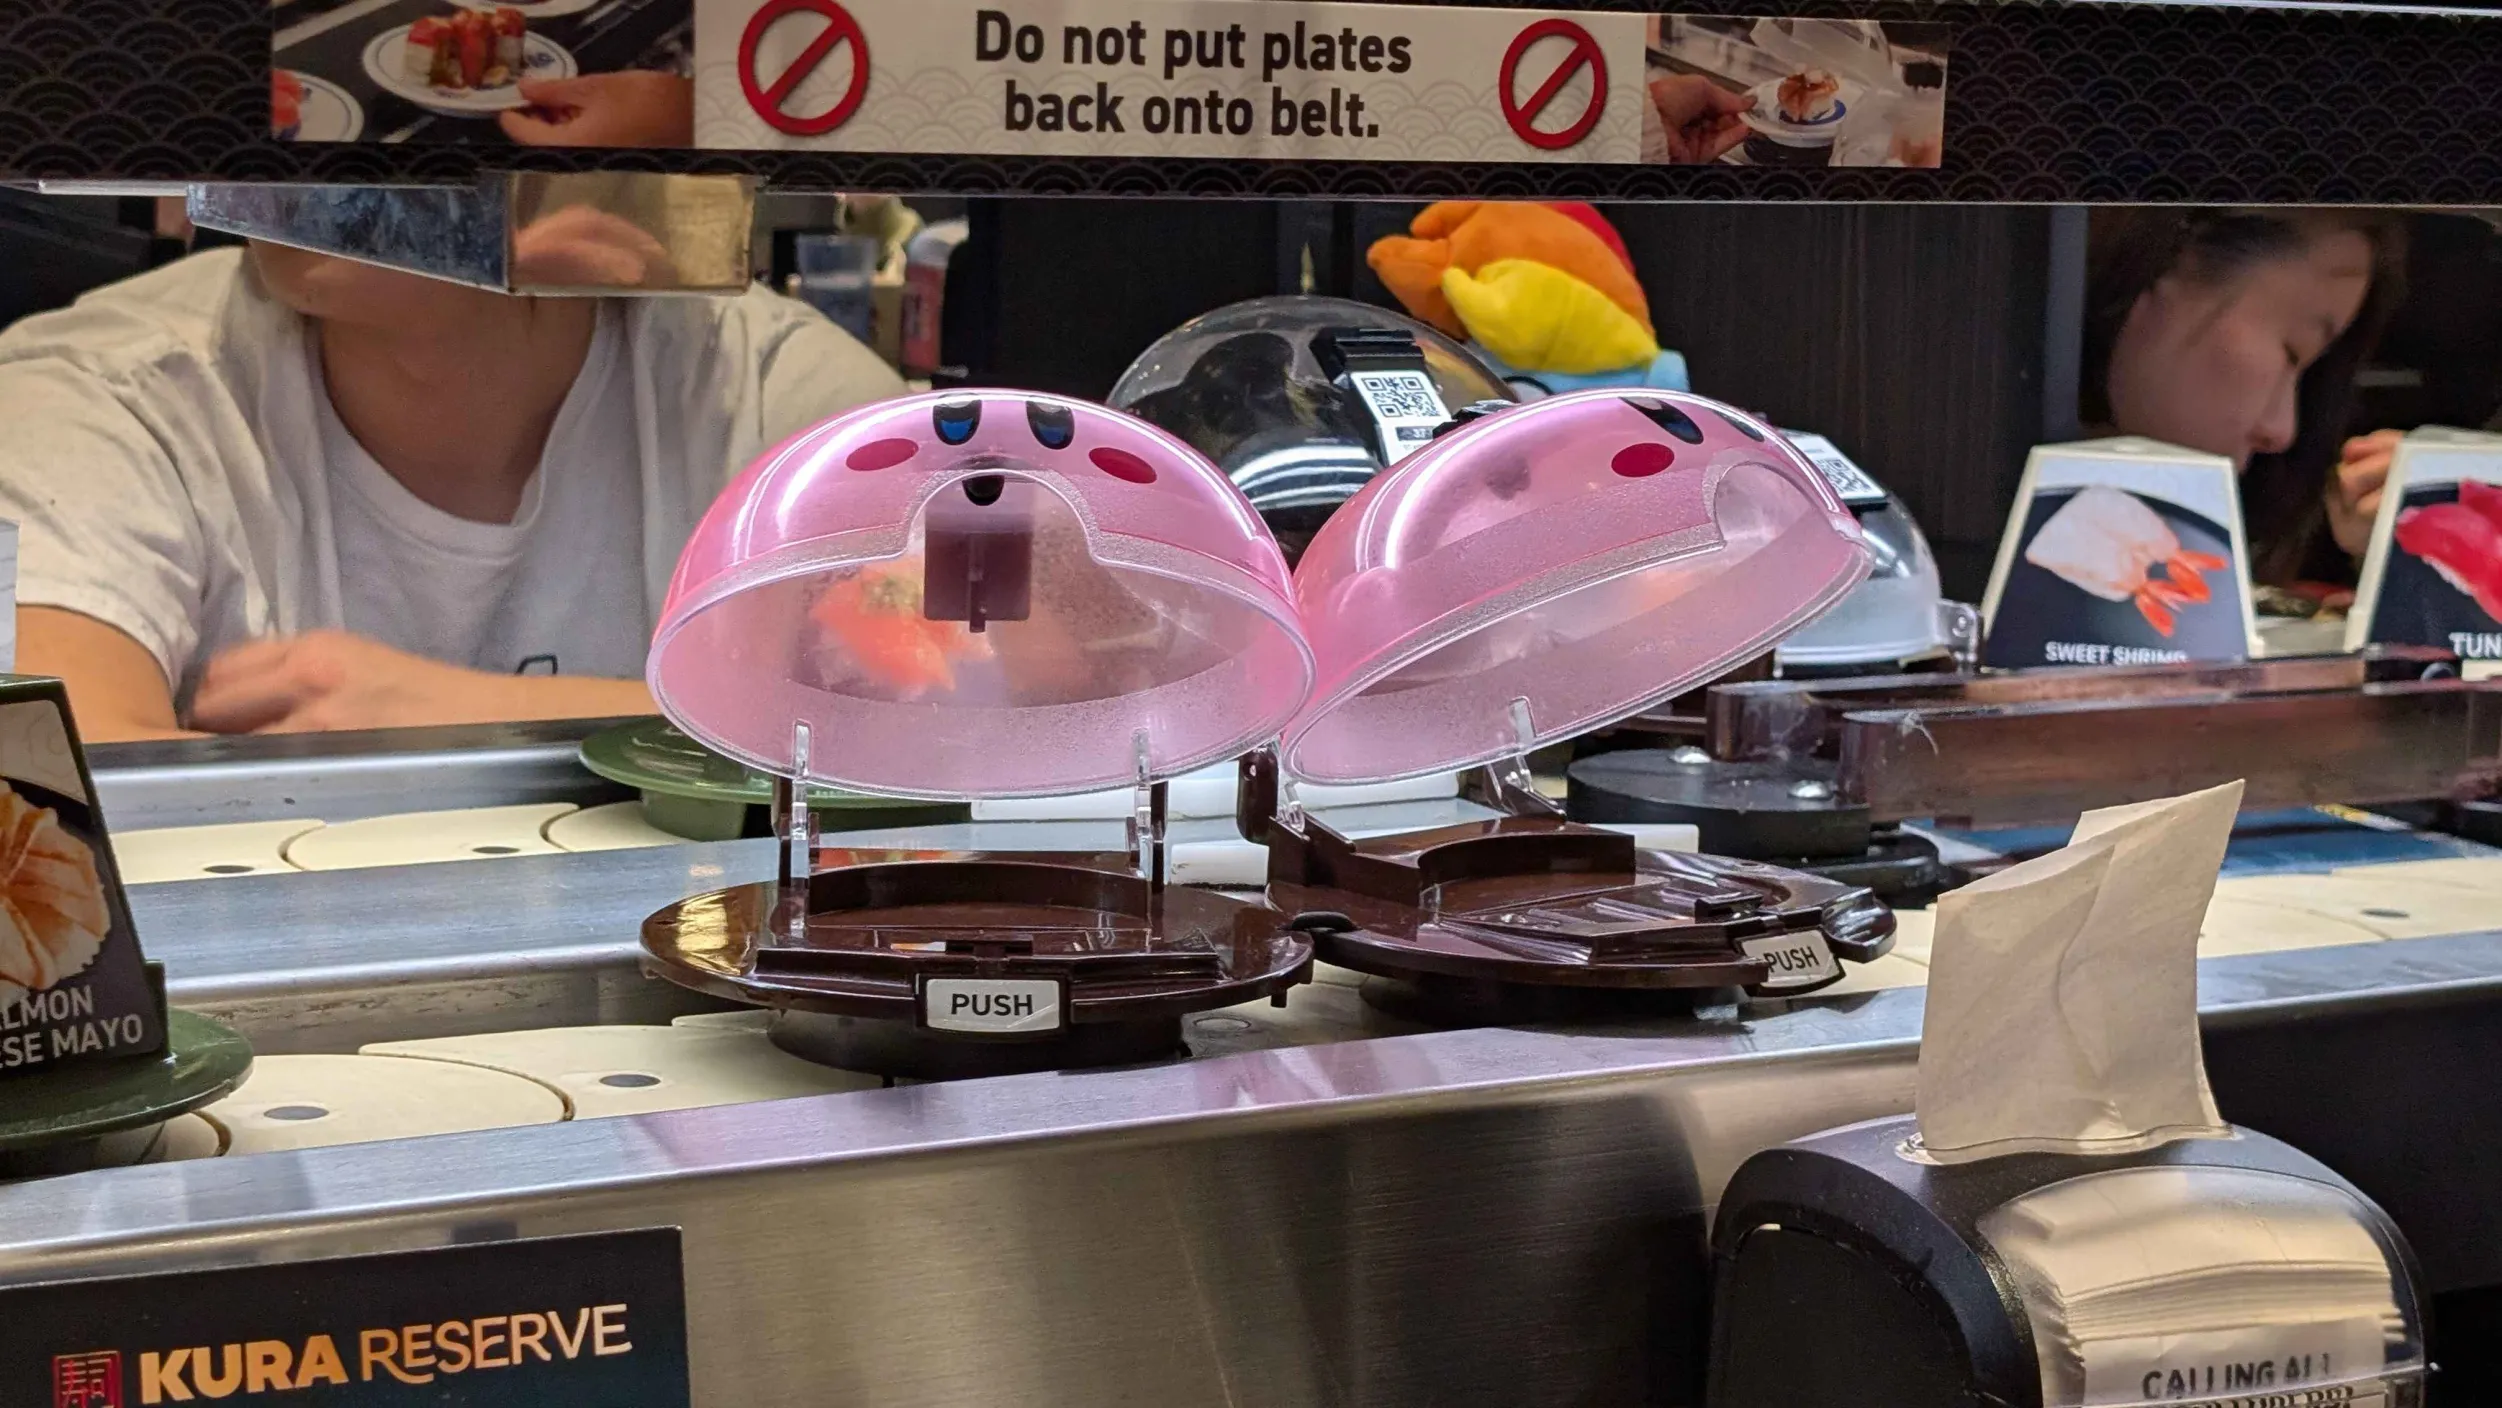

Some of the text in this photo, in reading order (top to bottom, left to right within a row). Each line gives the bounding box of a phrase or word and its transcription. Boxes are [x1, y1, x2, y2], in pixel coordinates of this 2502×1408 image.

[975, 9, 1412, 82] Do not put plates
[1004, 80, 1380, 139] back onto belt.
[2044, 641, 2110, 665] SWEET
[2448, 632, 2502, 659] TUN
[1763, 945, 1820, 974] PUSH
[0, 985, 94, 1032] LMON
[950, 993, 1034, 1017] PUSH
[0, 1013, 144, 1069] SE MAYO
[139, 1303, 633, 1405] KURA RESERVE
